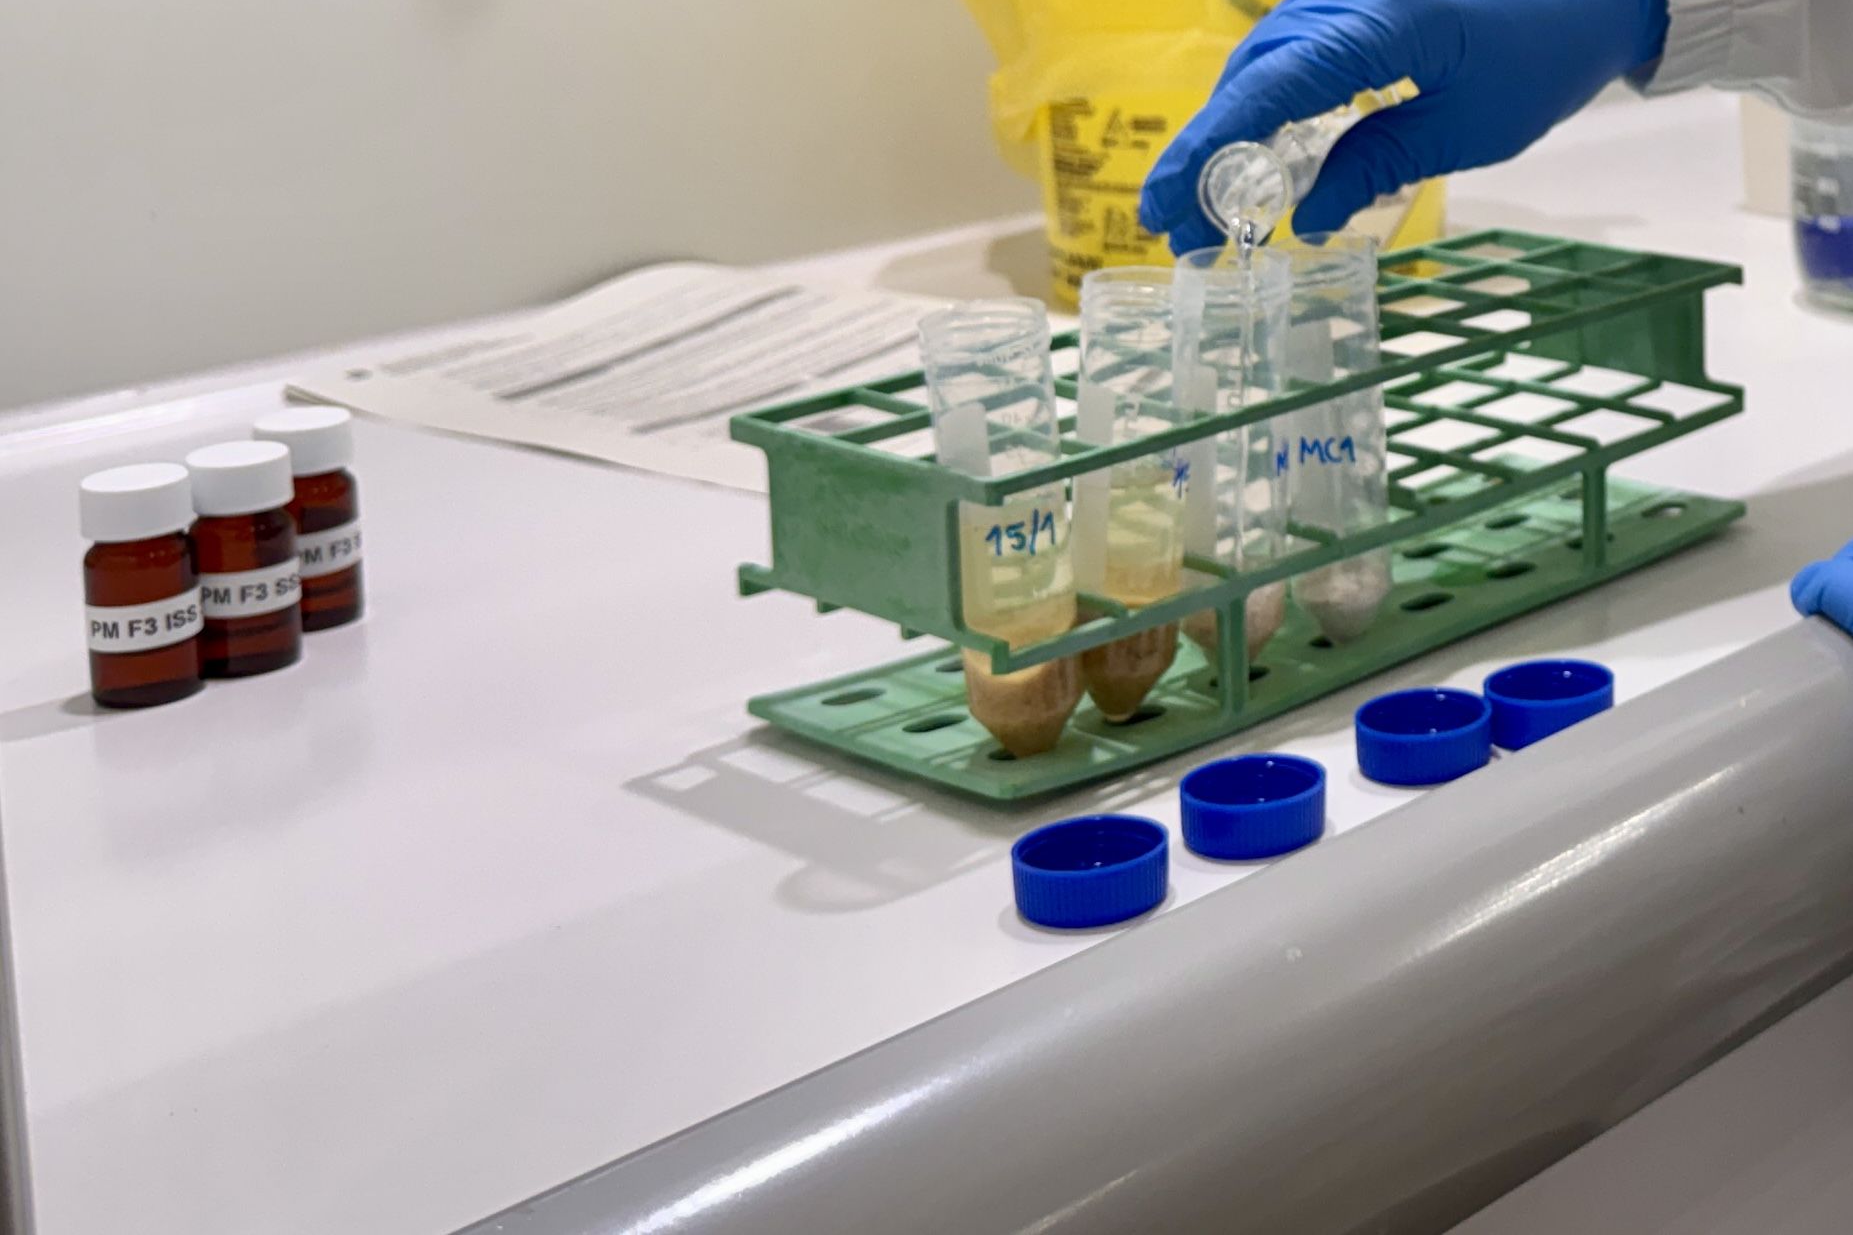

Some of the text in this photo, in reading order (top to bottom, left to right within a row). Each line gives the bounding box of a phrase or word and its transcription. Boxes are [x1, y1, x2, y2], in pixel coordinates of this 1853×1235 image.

[1299, 435, 1356, 464] MC1
[985, 508, 1056, 556] 15/1
[300, 546, 323, 565] M
[200, 585, 232, 604] PM
[240, 583, 268, 603] F3
[91, 604, 198, 639] PM F3 ISS
